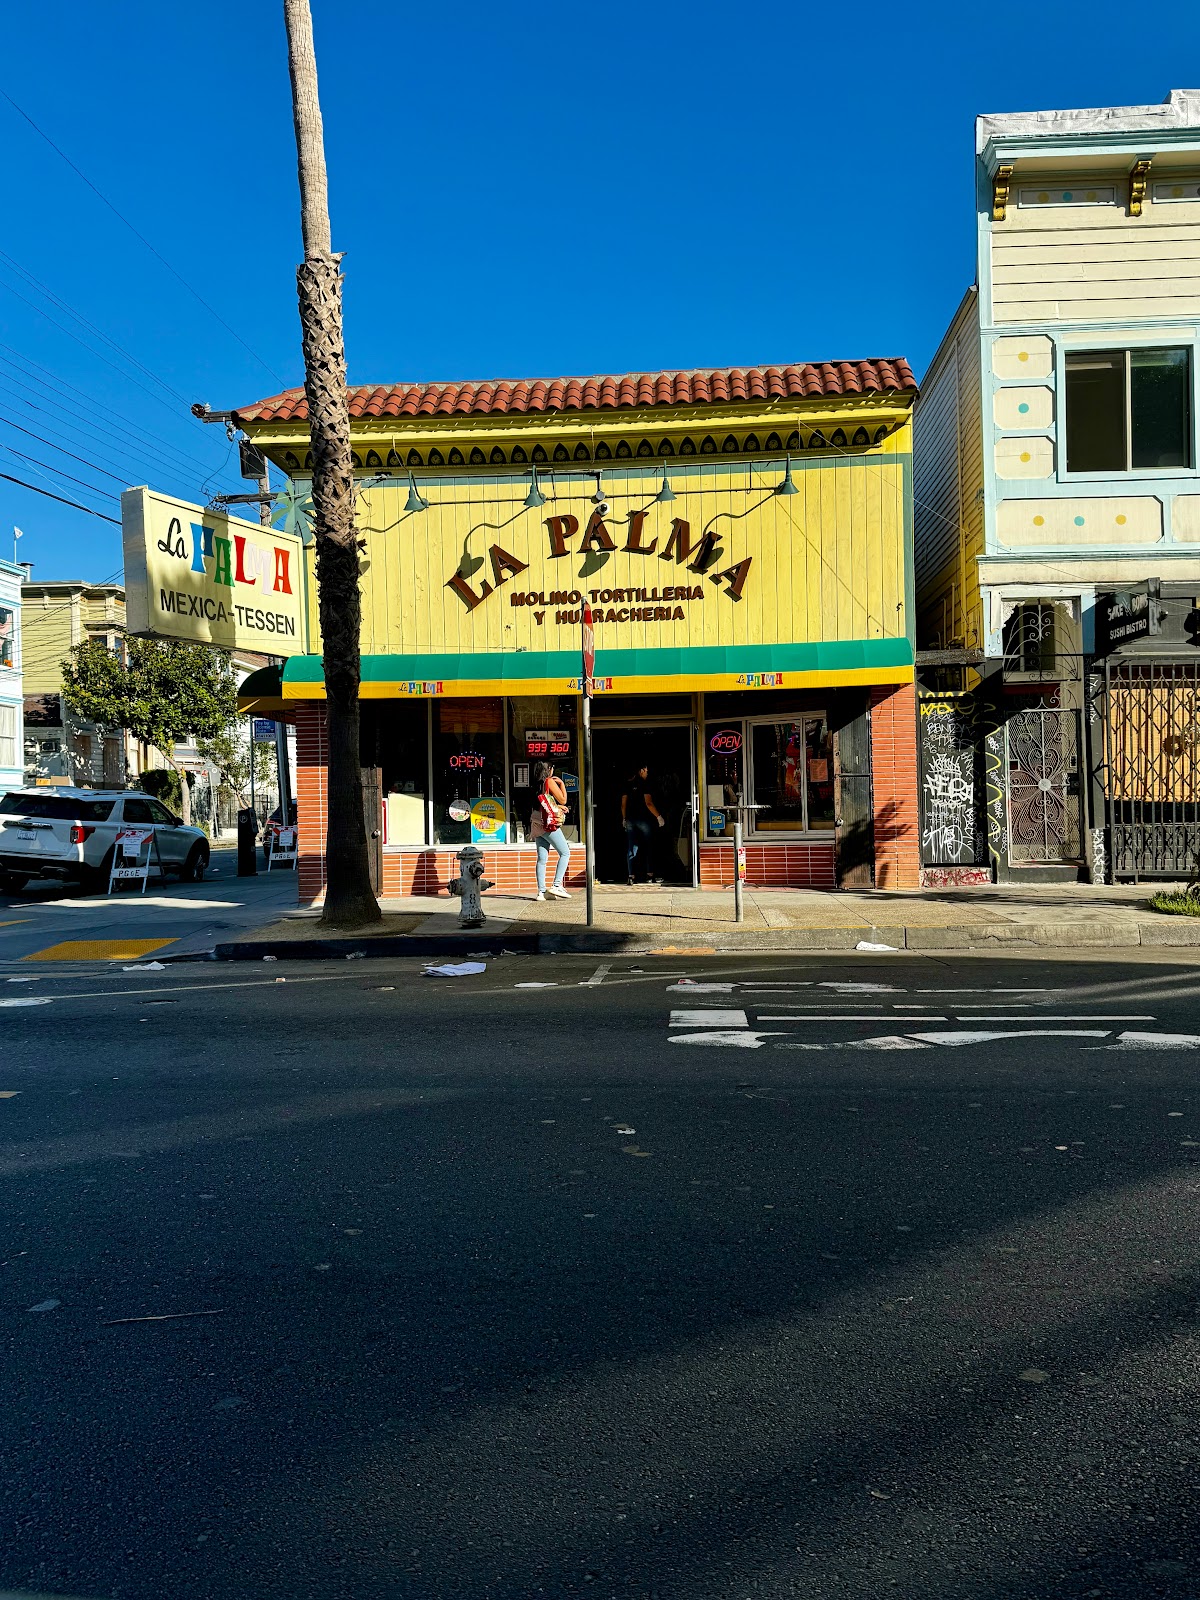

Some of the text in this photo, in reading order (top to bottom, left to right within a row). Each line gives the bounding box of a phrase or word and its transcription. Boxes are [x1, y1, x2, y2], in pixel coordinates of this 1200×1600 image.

[157, 517, 293, 597] La PALMA
[444, 510, 753, 614] LA PALMA
[510, 586, 704, 607] MOLINO TORTILLERIA
[1107, 592, 1148, 621] SAKE BOMB
[160, 588, 296, 637] MEXICA-TESSEN
[533, 606, 685, 626] Y HURACHERIA
[1109, 618, 1147, 640] SUSHI BISTRO
[408, 681, 444, 695] PALMA
[746, 672, 784, 687] PALMA
[528, 742, 570, 753] 999 360
[713, 735, 741, 749] OPEN
[449, 755, 483, 768] OPEN
